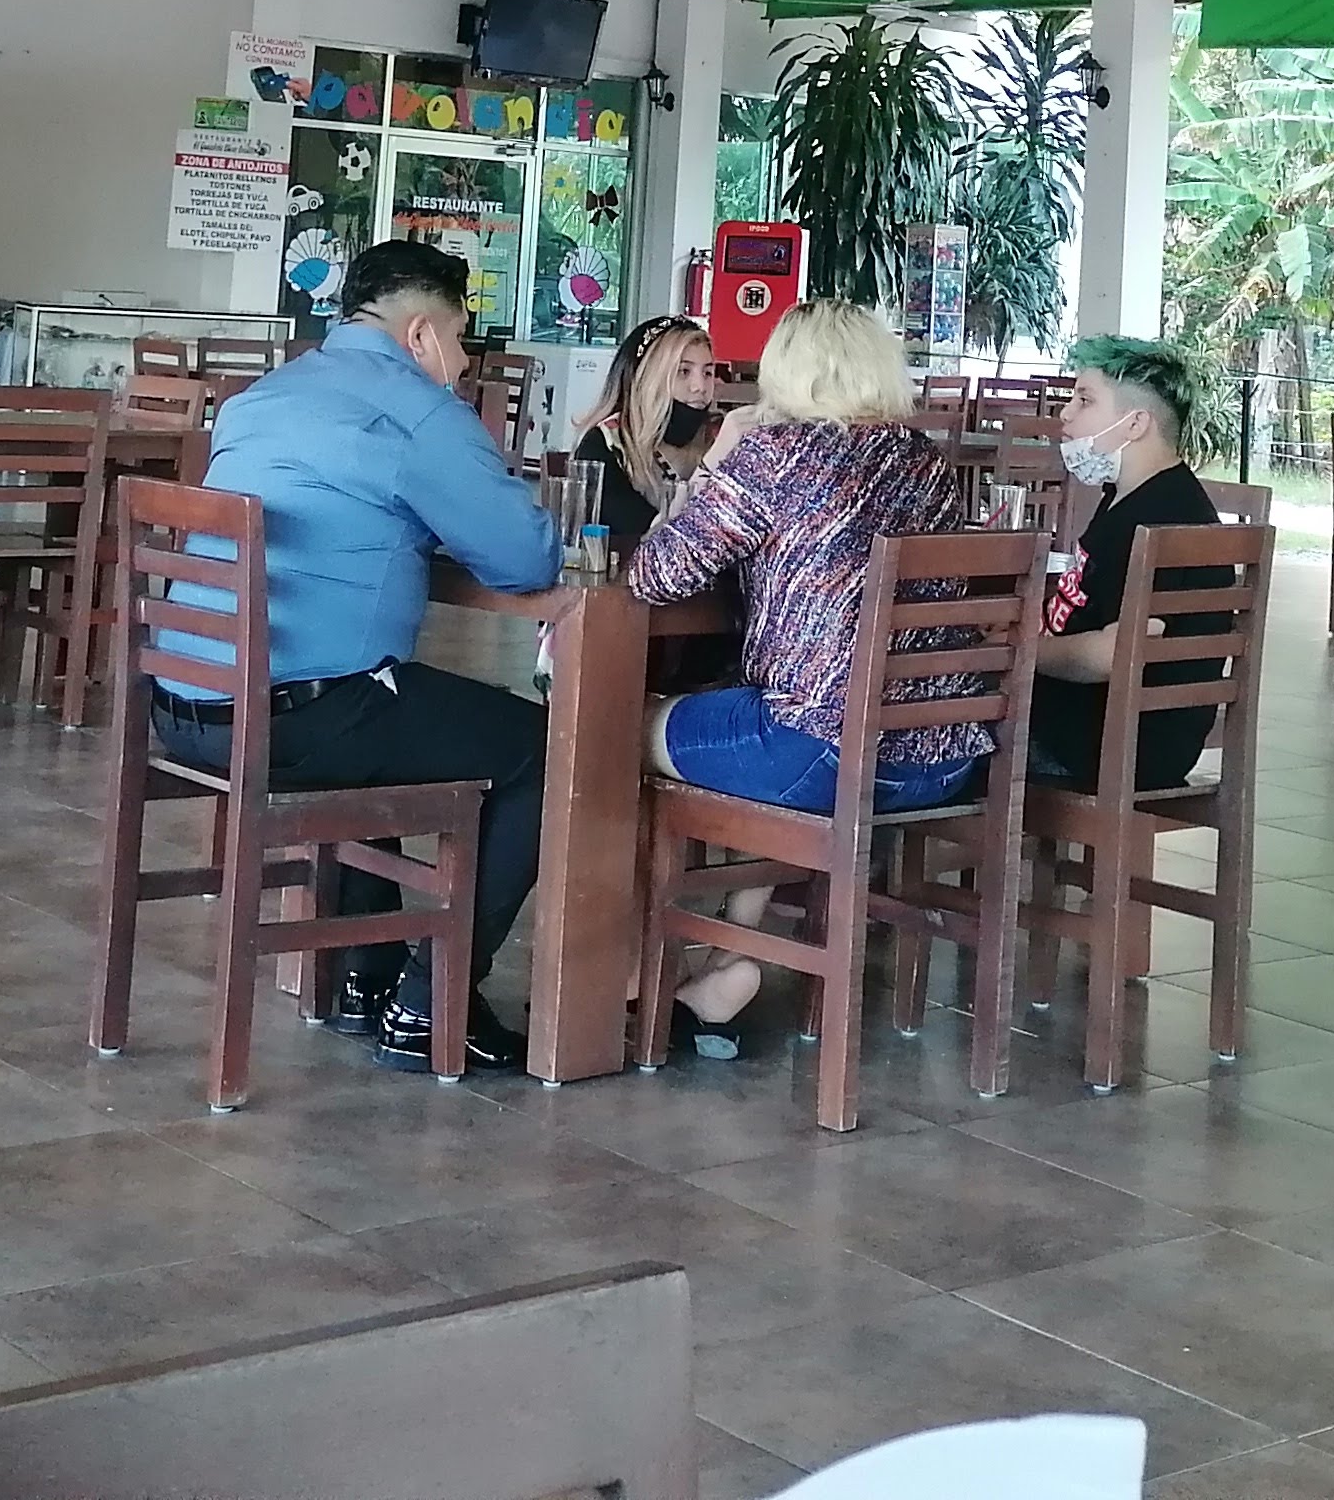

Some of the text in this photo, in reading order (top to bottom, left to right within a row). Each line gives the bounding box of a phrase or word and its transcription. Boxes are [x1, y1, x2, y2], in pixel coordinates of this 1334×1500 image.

[242, 34, 256, 42] POR
[266, 38, 304, 48] MOMENTO
[235, 42, 306, 59] NO CONTAMOS
[245, 55, 296, 68] CON TERMINAL
[181, 155, 284, 173] ZONA DE ANTOJITOS
[184, 169, 277, 184] PLATANITOS RELLENOS
[210, 181, 251, 192] TOSTONES
[190, 188, 269, 202] TORREJAS DE YUCA
[191, 199, 267, 211] TORTILLA DE YUCA
[412, 195, 504, 214] RESTAURANTE
[174, 206, 213, 216] TORTILLA
[216, 209, 227, 218] DE
[201, 221, 238, 230] TAMALES
[180, 229, 209, 239] ELOTE,
[250, 234, 271, 242] PAVO
